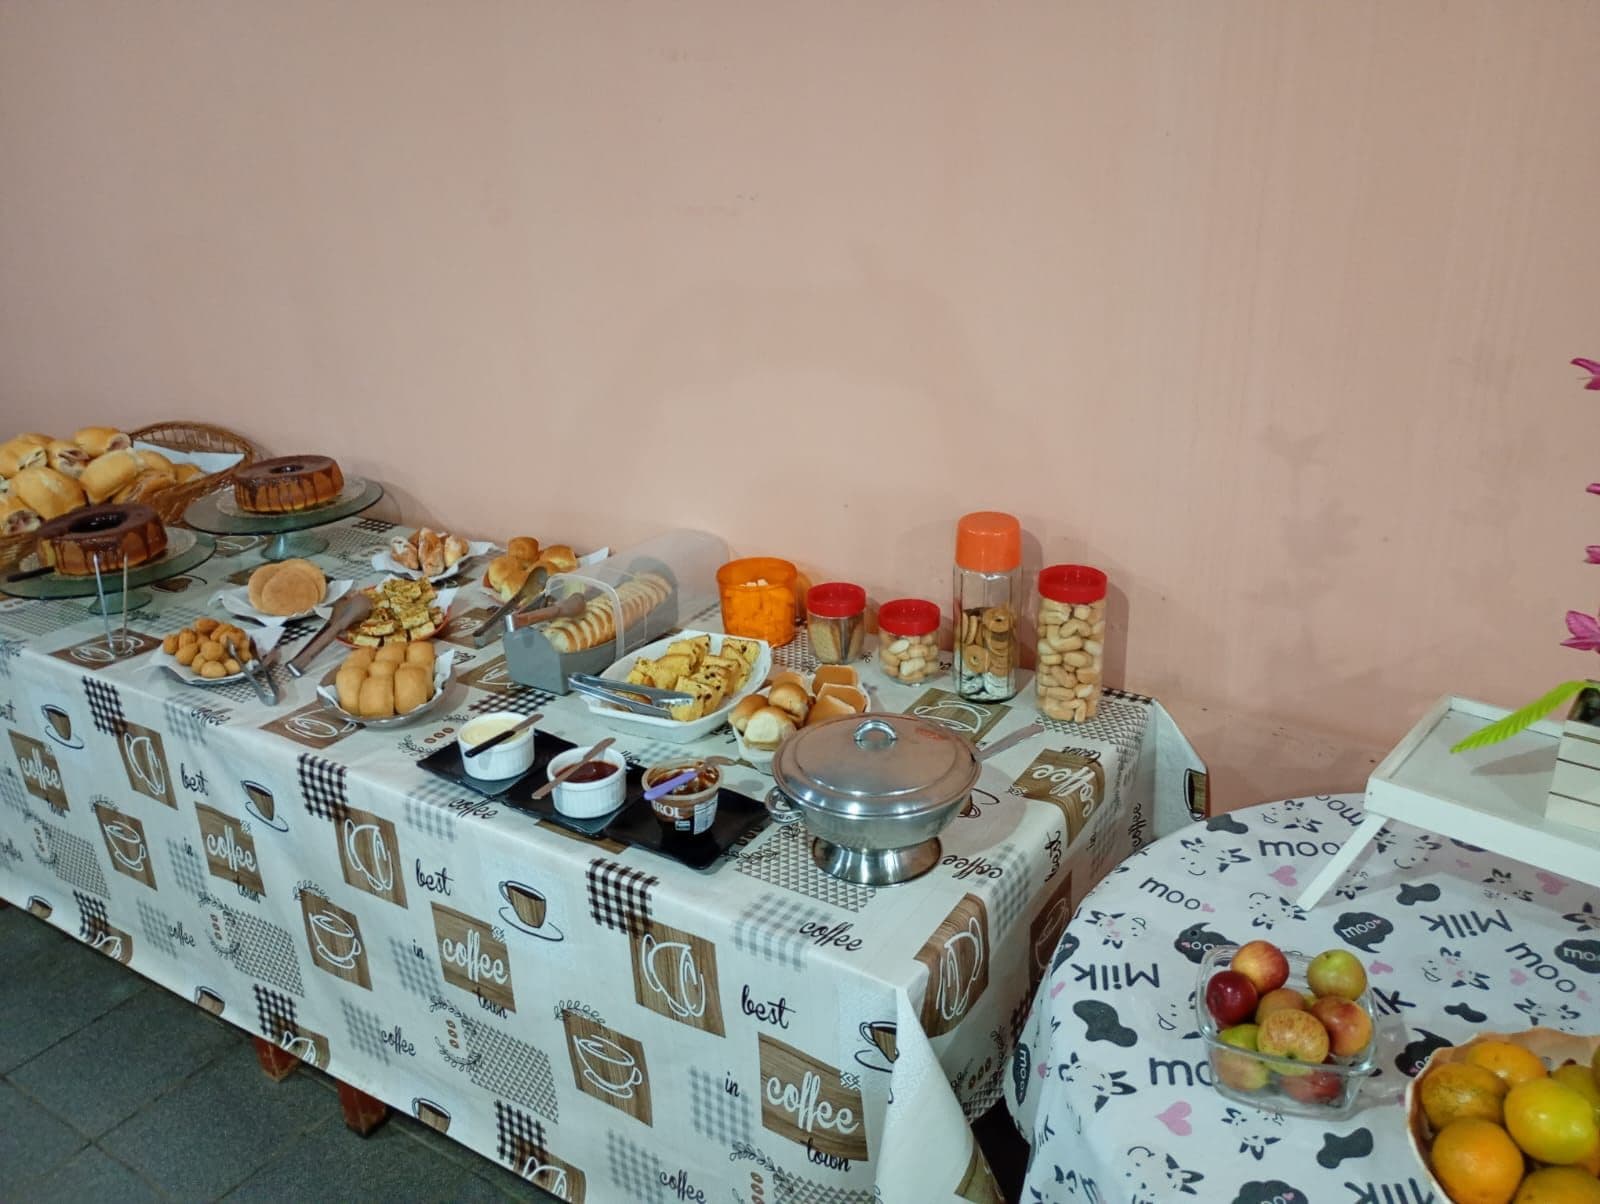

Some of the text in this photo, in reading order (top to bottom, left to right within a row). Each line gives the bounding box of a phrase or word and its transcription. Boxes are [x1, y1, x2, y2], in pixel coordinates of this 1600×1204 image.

[191, 706, 232, 726] coffee
[20, 747, 61, 790] coffee
[180, 763, 209, 796] best
[1031, 764, 1096, 818] coffee
[449, 798, 499, 820] coffee
[1128, 802, 1147, 848] coffee
[206, 824, 257, 872] coffee
[1257, 839, 1341, 857] moo
[415, 858, 454, 896] best
[942, 854, 1004, 880] coffee
[1138, 877, 1201, 910] moo
[169, 921, 196, 948] coffee
[799, 921, 864, 951] coffee
[1340, 919, 1377, 938] moo
[1420, 909, 1513, 939] Milk
[411, 938, 425, 960] in
[442, 928, 508, 984] coffee
[1071, 962, 1160, 991] Milk
[1504, 942, 1577, 993] moo
[474, 987, 508, 1020] town
[741, 984, 797, 1029] best
[380, 1025, 417, 1057] coffee
[724, 1071, 741, 1098] in
[1018, 1049, 1031, 1092] moo
[766, 1070, 861, 1135] coffee
[805, 1137, 852, 1172] town
[659, 1169, 706, 1204] coffee
